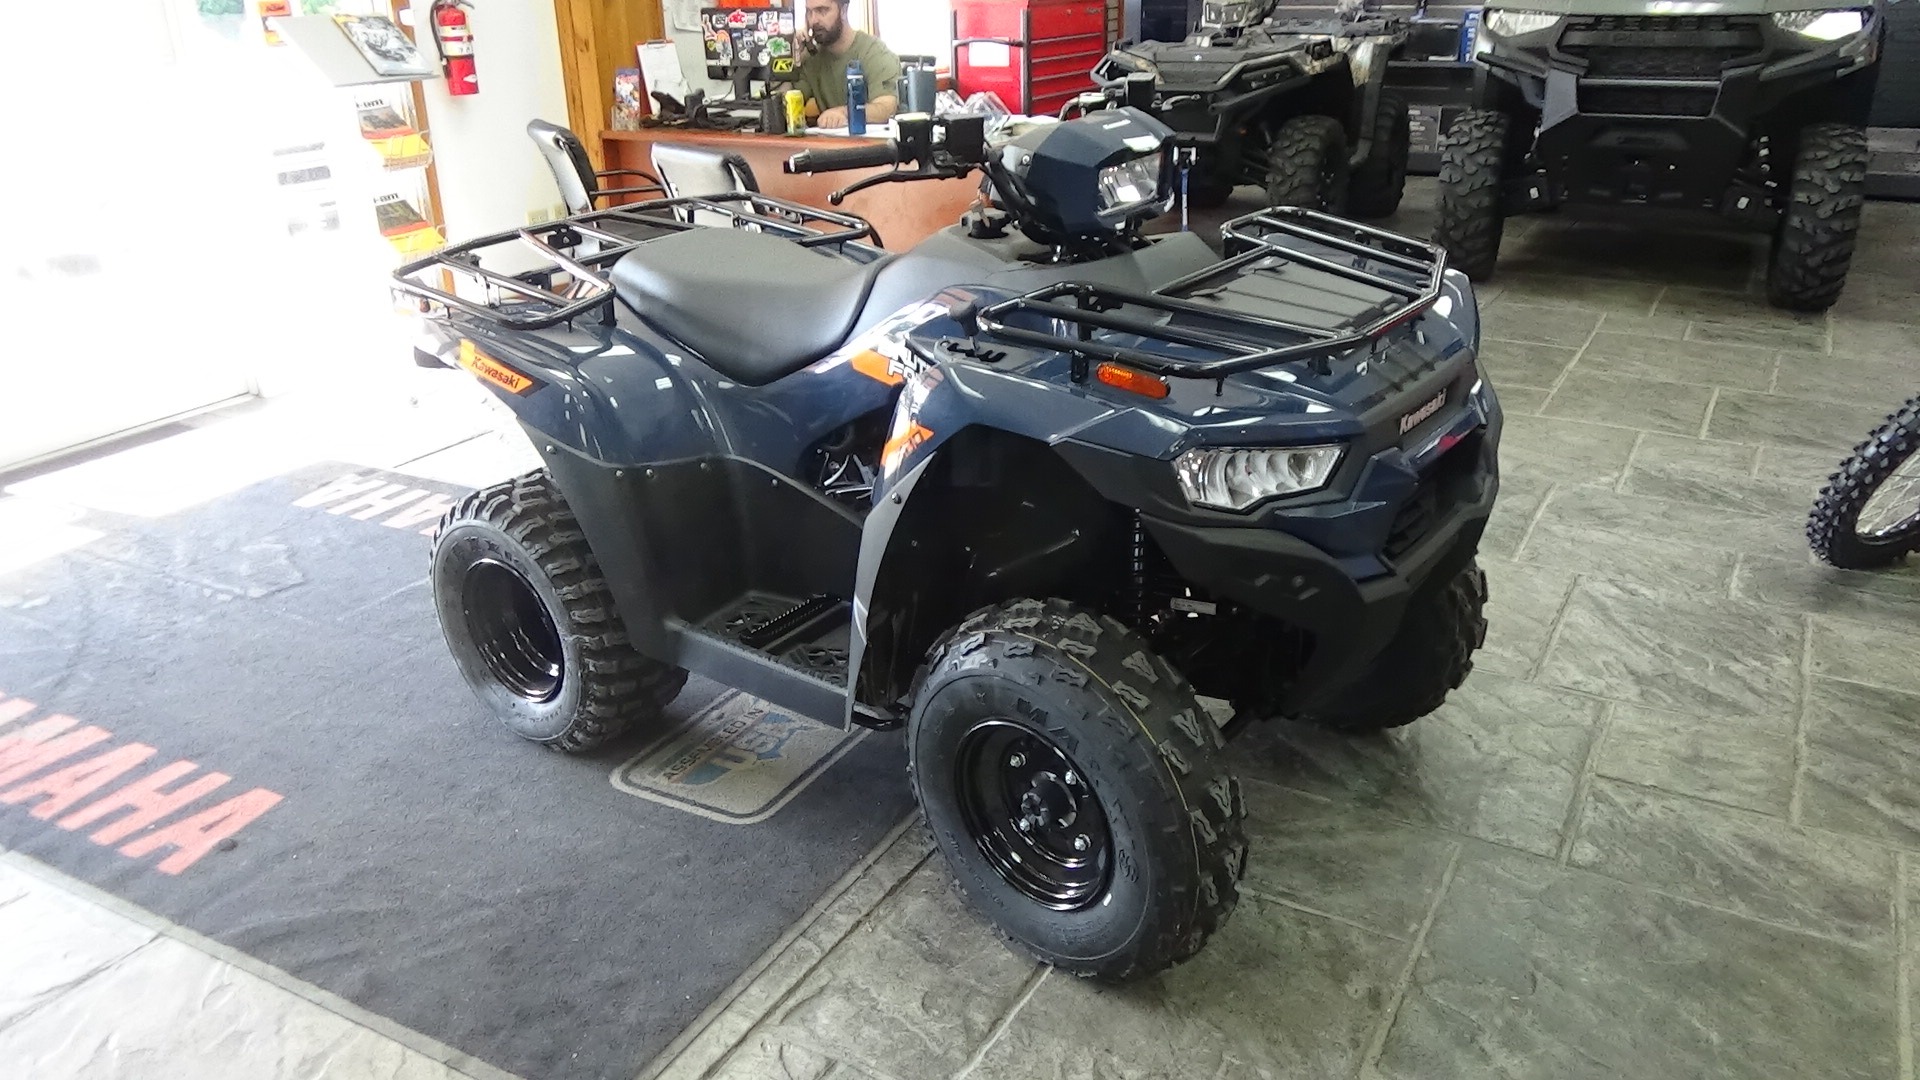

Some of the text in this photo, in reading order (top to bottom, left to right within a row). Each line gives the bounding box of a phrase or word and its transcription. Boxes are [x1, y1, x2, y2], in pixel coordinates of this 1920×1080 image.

[471, 356, 520, 389] Kawasaki
[1399, 388, 1447, 435] Kawasaki
[292, 473, 458, 537] AHA
[743, 706, 765, 722] IN
[0, 690, 285, 876] MAHA
